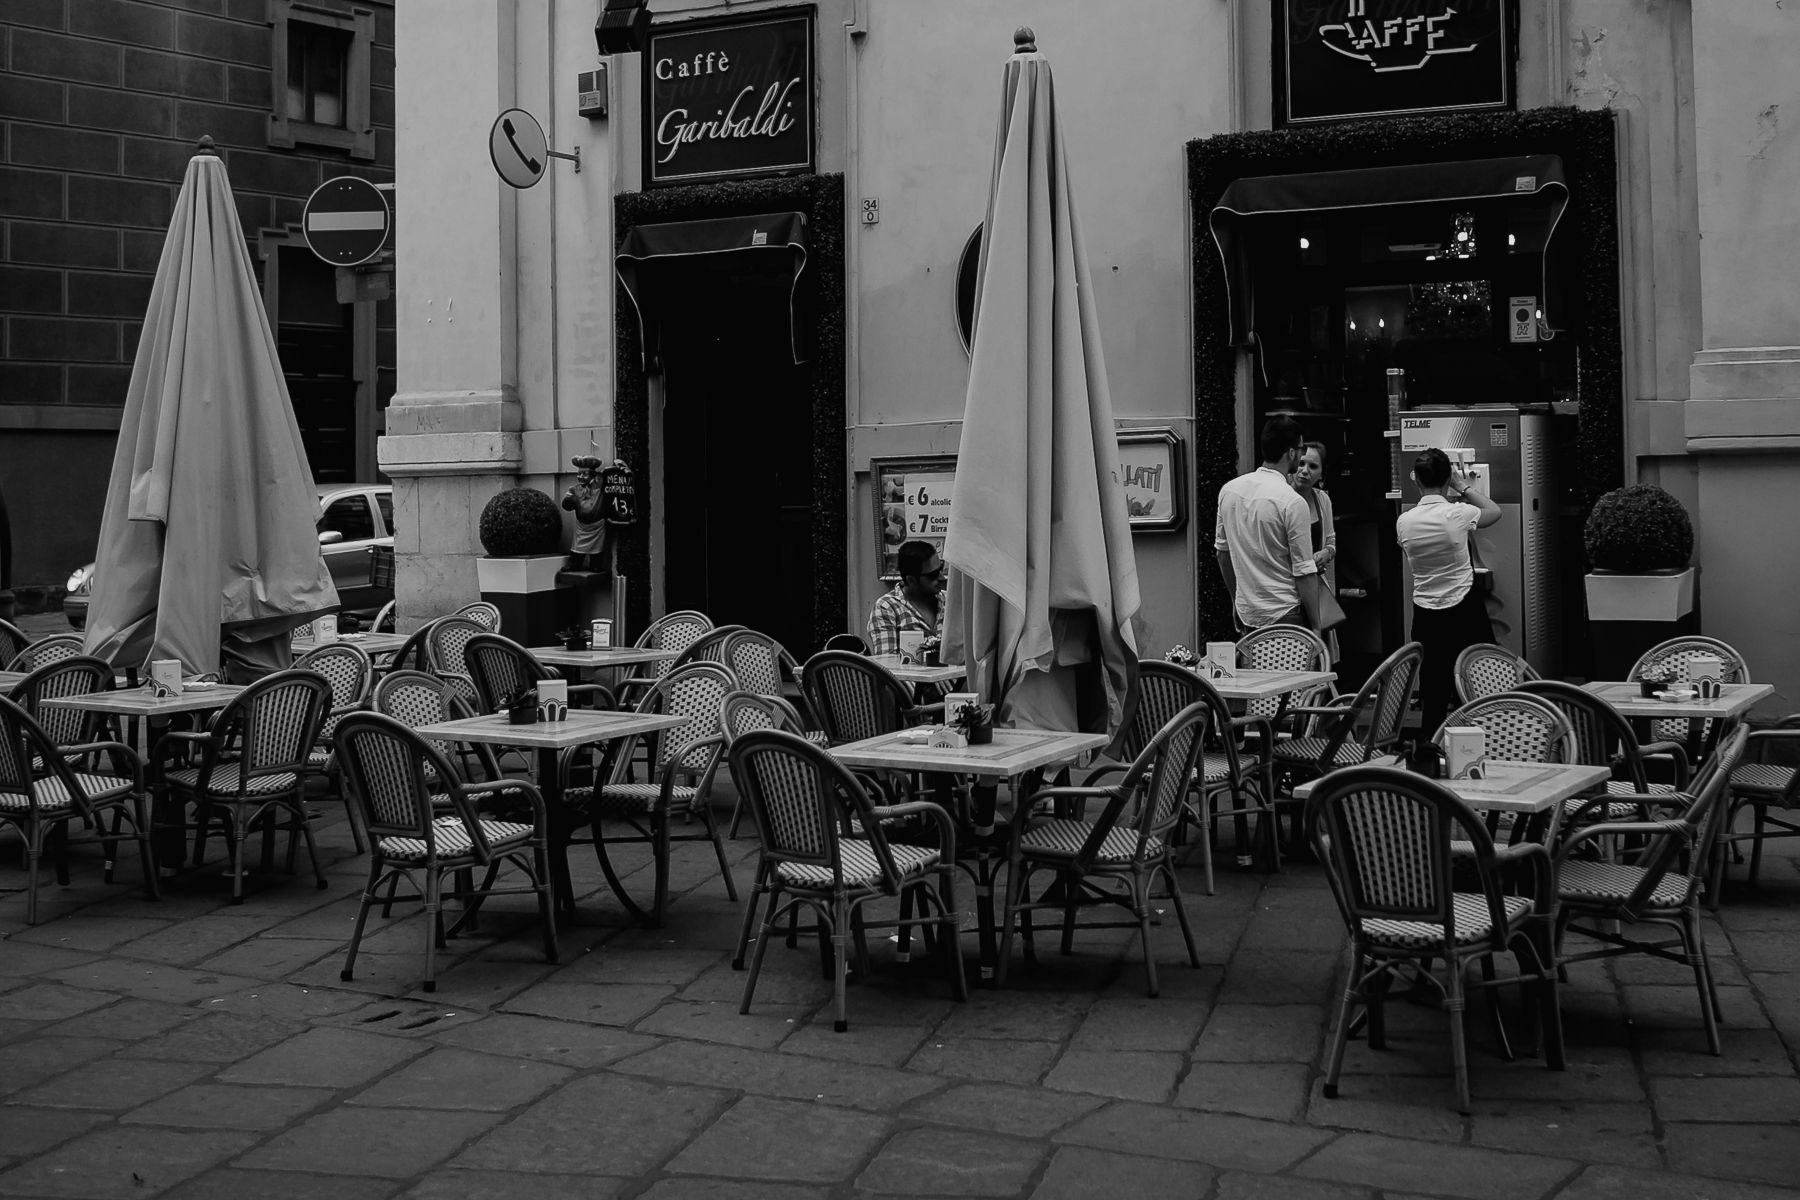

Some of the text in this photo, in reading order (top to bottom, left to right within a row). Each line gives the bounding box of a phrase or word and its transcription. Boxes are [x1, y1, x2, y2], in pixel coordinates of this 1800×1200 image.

[655, 51, 730, 80] Caffè
[657, 77, 801, 163] Garibaldi
[863, 199, 877, 210] 34
[1404, 419, 1432, 429] TELME
[1121, 463, 1163, 492] LATI
[611, 496, 628, 516] 13
[917, 486, 929, 506] 6
[918, 514, 929, 533] 7
